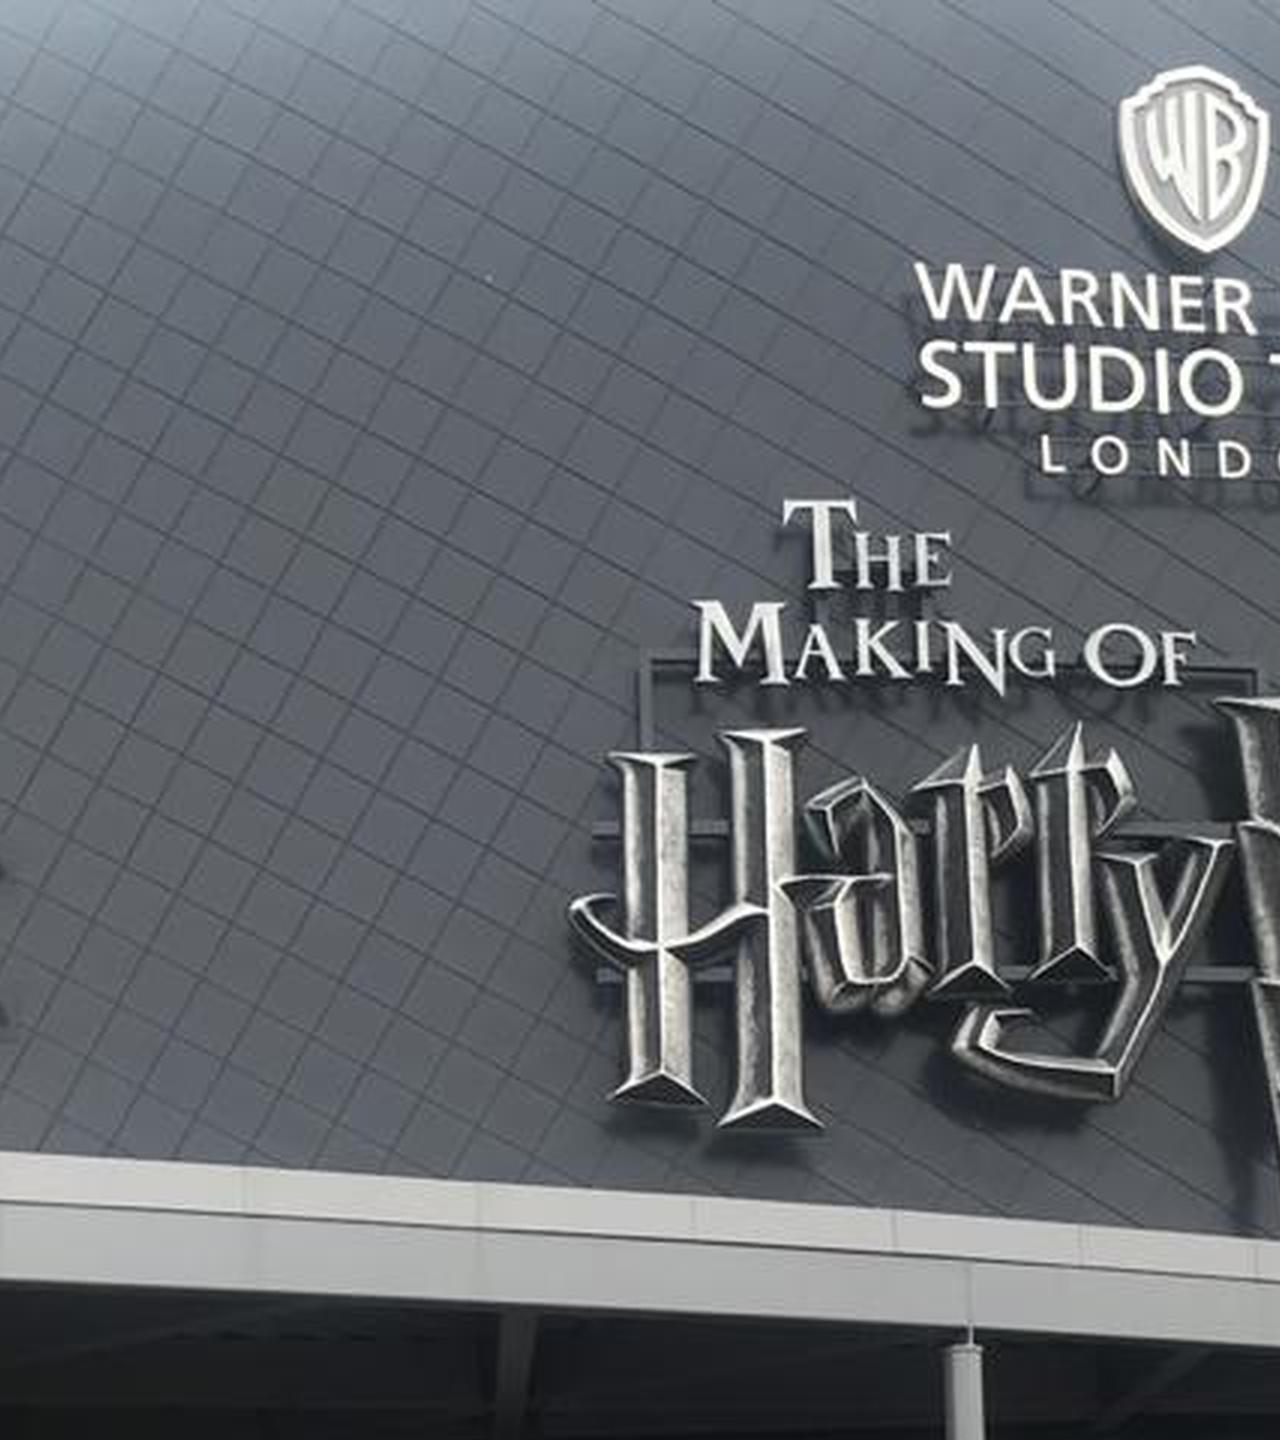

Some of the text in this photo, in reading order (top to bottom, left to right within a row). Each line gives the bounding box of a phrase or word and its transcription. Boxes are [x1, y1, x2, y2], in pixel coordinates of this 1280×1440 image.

[1144, 88, 1248, 223] WB
[914, 262, 1258, 336] WARNER
[920, 340, 1244, 417] STUDIO
[1084, 622, 1197, 688] OF
[570, 720, 1235, 1130] Harry
